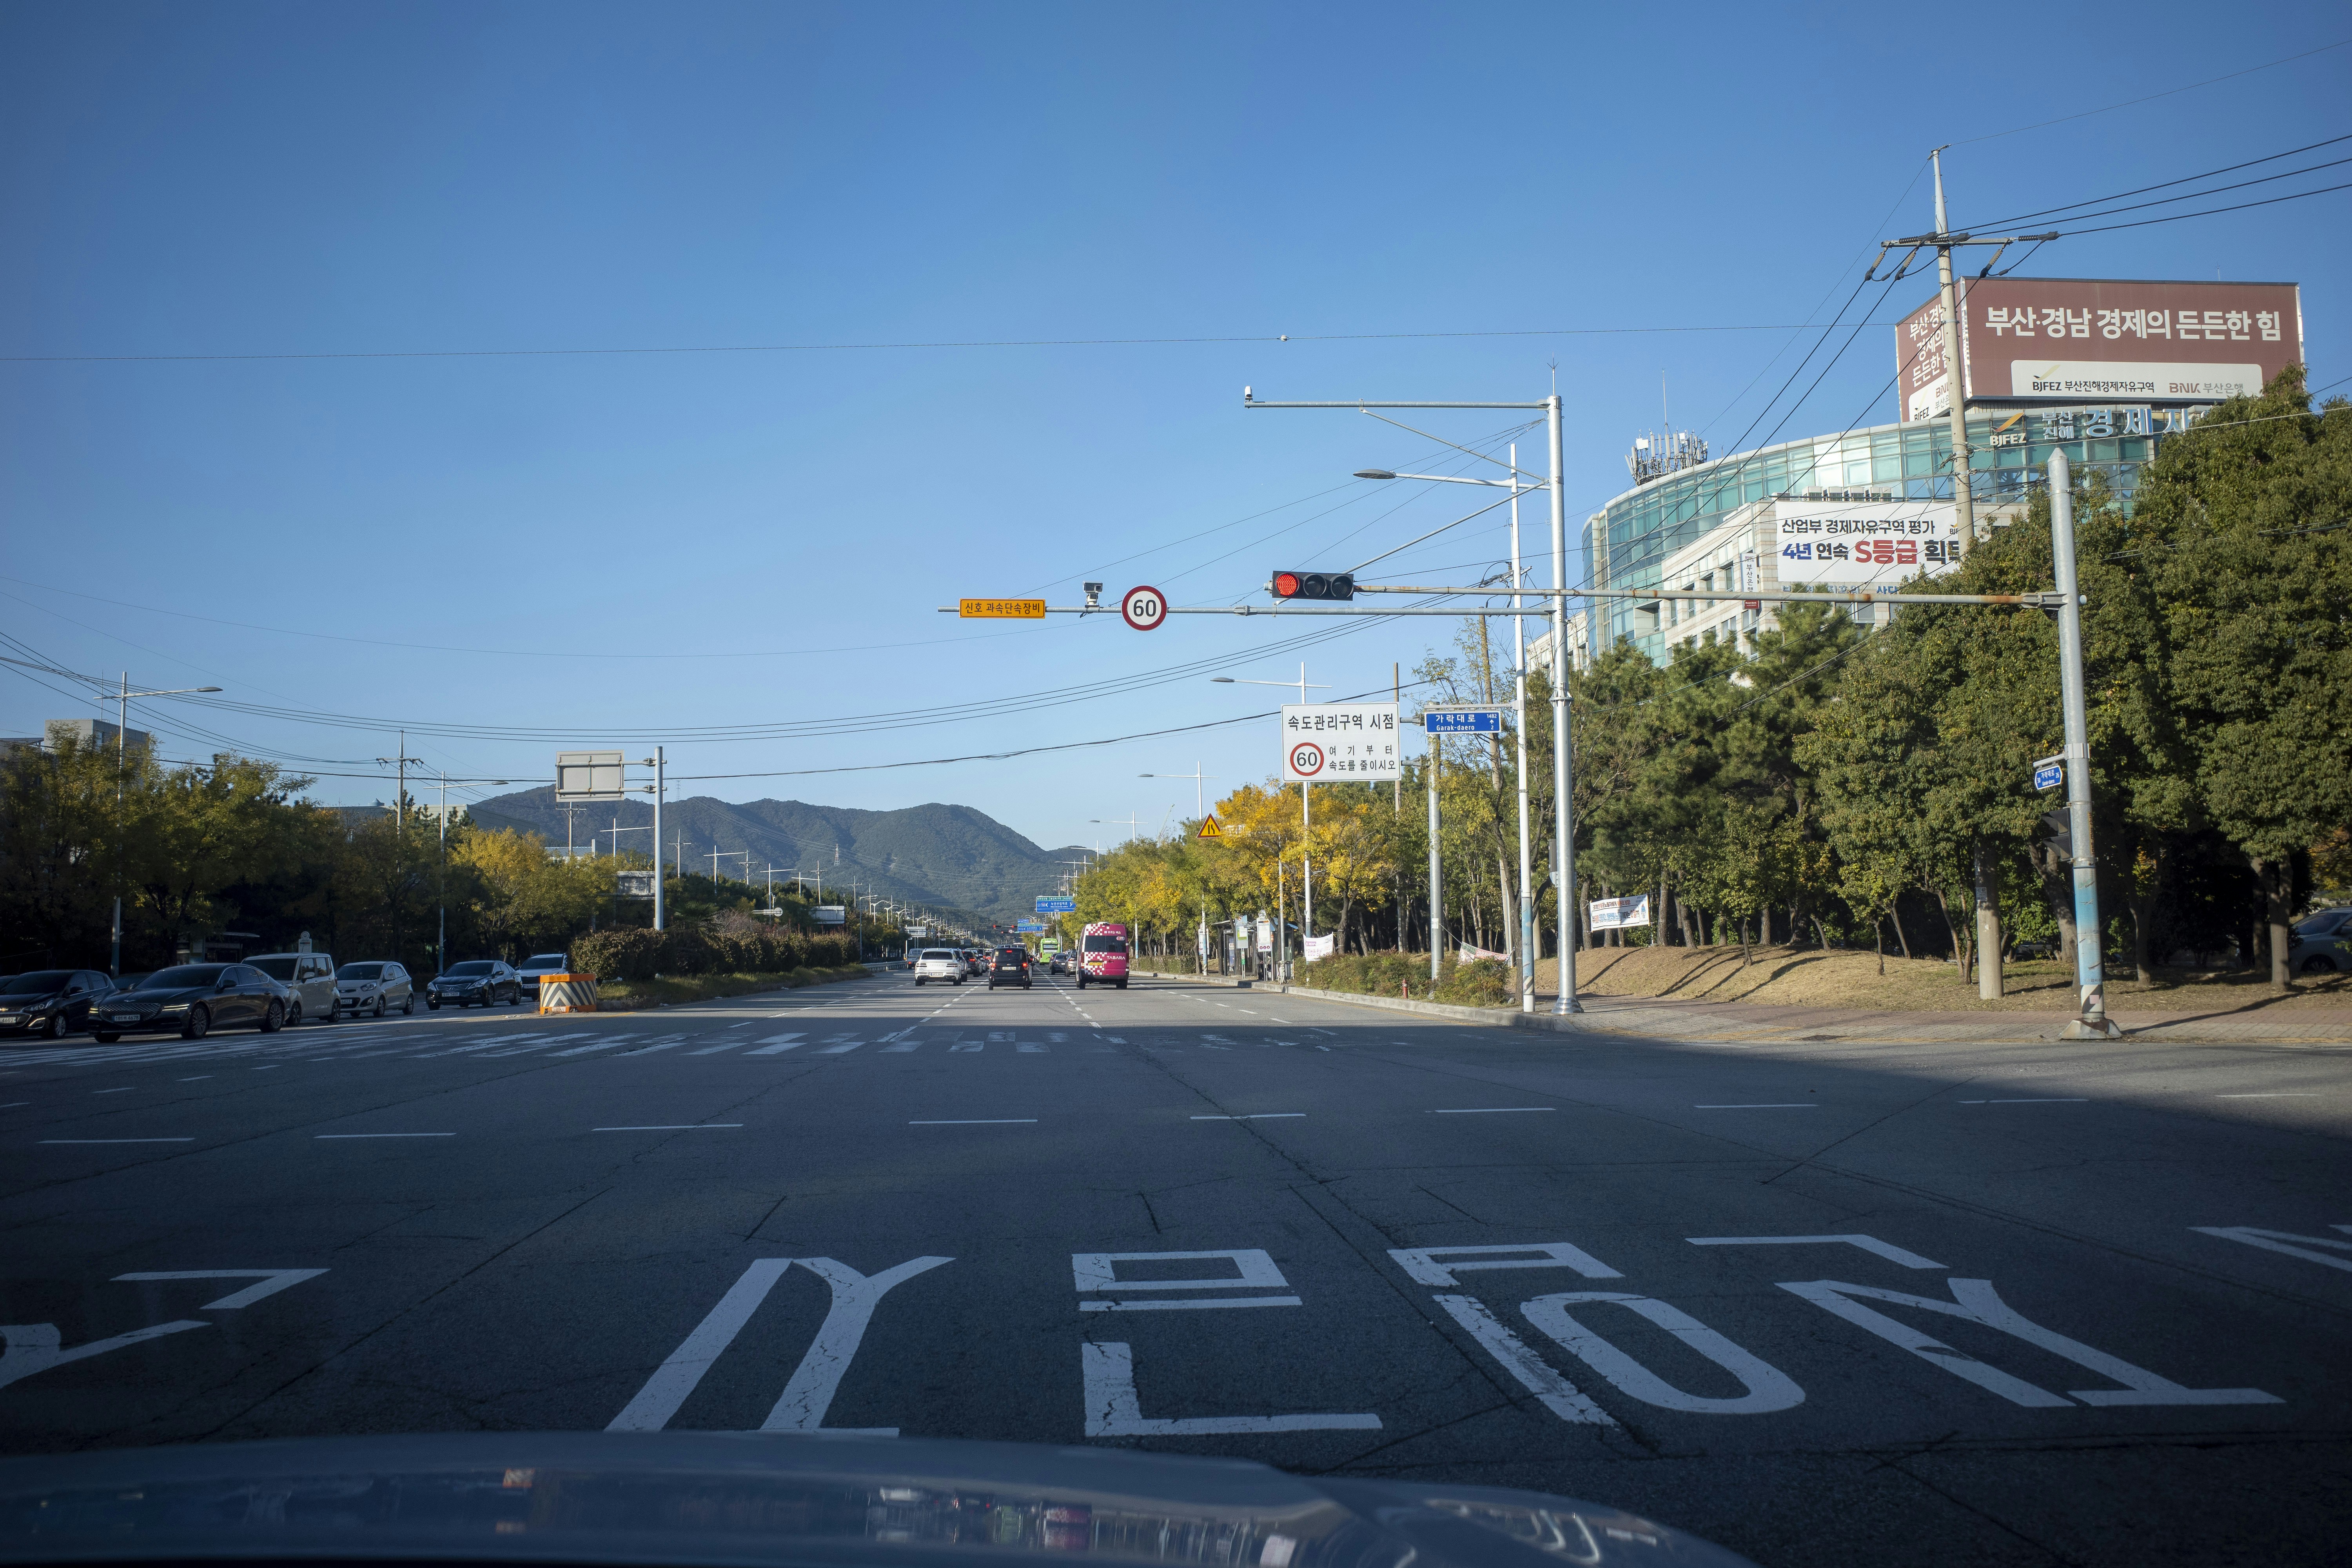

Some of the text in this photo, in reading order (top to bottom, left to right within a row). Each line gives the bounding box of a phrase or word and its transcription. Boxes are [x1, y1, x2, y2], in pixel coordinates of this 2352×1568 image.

[1985, 307, 2281, 341] 부산·경남 경제의 든든한 힘
[1912, 352, 1940, 388] 든든한
[2033, 381, 2155, 393] BJFEZ 부산진해경제자유구역
[2169, 382, 2244, 394] BNK 부산은행
[2042, 408, 2206, 438] 부산 경제자
[1990, 433, 2027, 447] BJFEZ
[2043, 425, 2074, 440] 진해
[1782, 519, 1935, 534] 산업부 경제자유구역 평가
[1782, 543, 1812, 560] 4년
[1816, 543, 1849, 560] 연속
[1855, 540, 1918, 564] S등급
[965, 603, 1040, 615] 신호 과속단속장비
[1132, 599, 1157, 617] 60
[1288, 713, 1393, 731] 속도관리구역 시점
[1436, 714, 1476, 724] 가락대로
[1296, 751, 1318, 767] 60
[1329, 759, 1396, 771] 속도를 줄이시오
[2041, 769, 2055, 779] 가락대로
